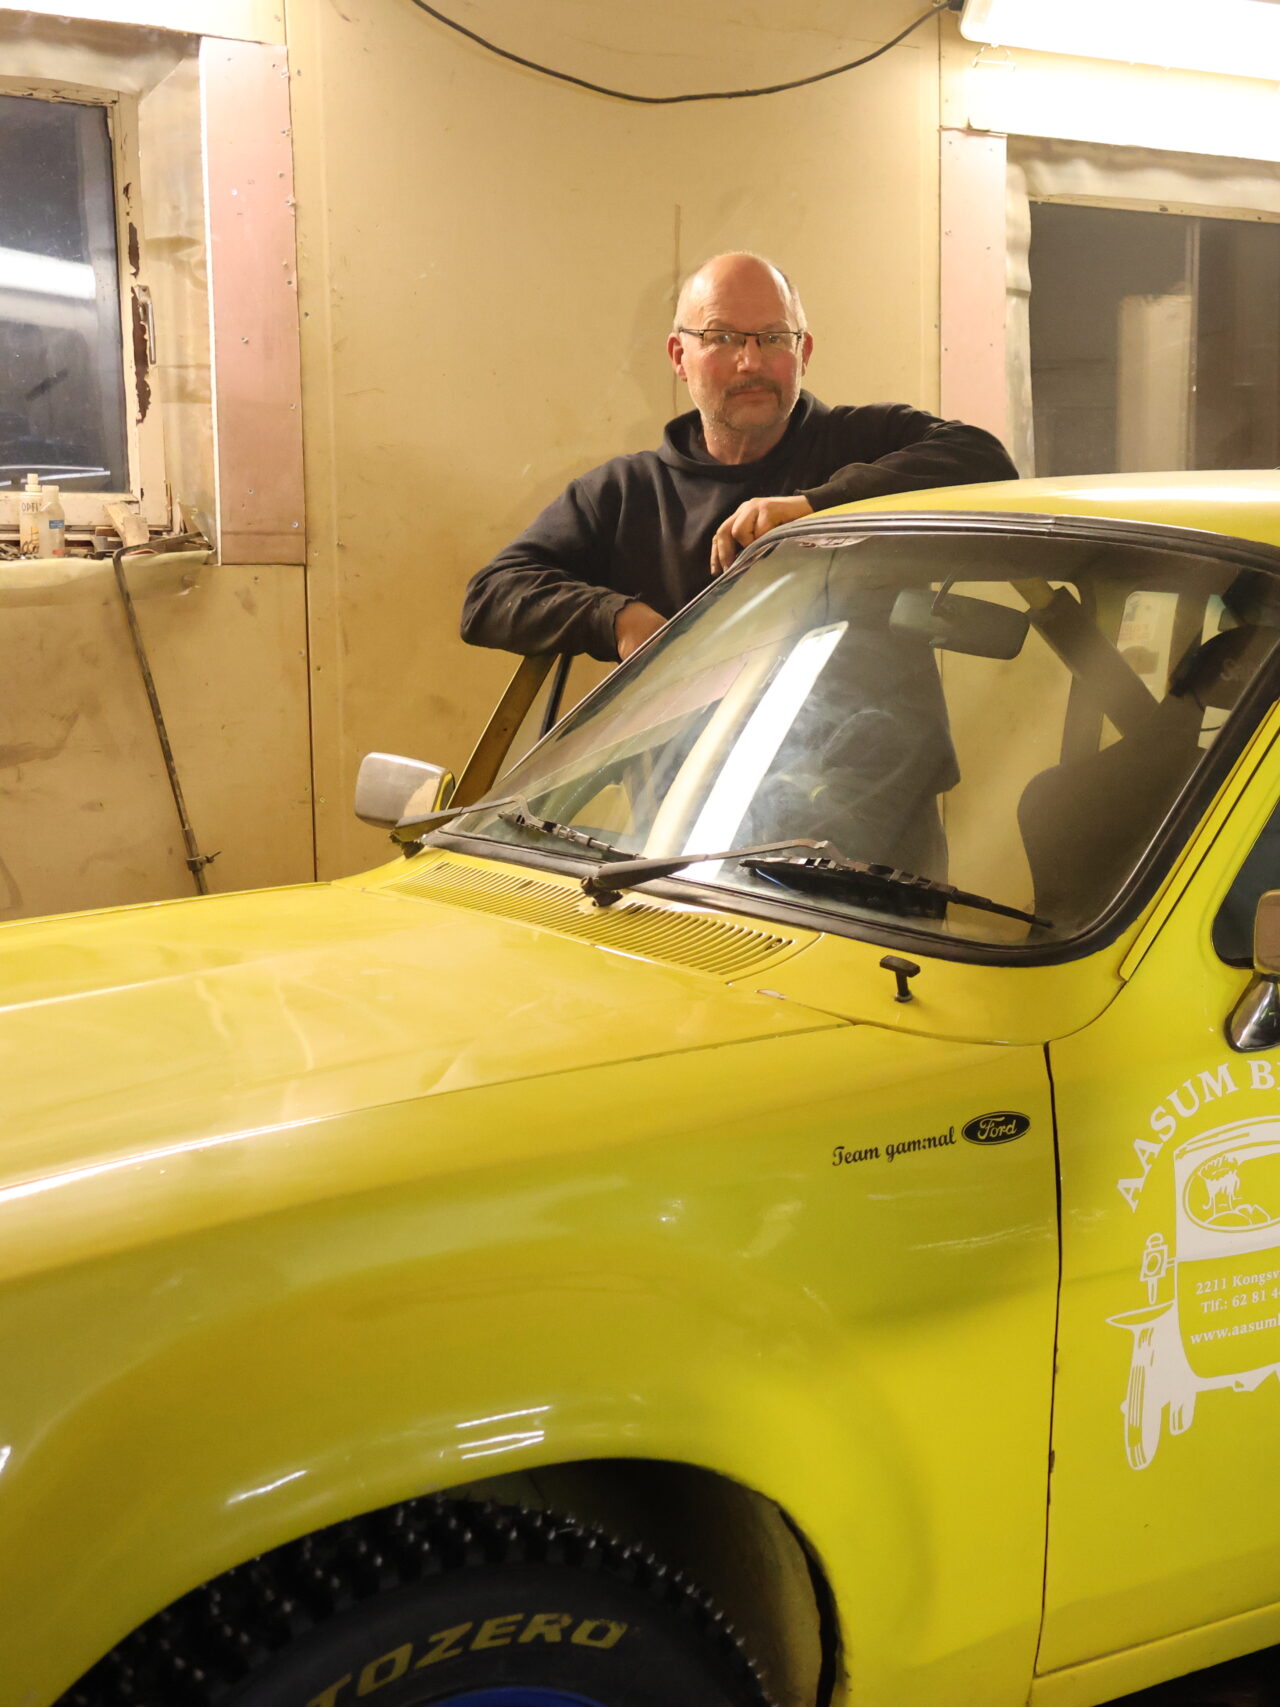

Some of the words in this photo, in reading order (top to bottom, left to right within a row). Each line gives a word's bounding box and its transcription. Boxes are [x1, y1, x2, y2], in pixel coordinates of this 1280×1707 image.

[832, 1146, 881, 1166] Team
[977, 1116, 1018, 1140] Ford
[1116, 1062, 1239, 1213] AASUM
[1196, 1277, 1227, 1295] 2211
[1201, 1298, 1228, 1314] Tlf.:
[1232, 1294, 1247, 1307] 62
[1252, 1290, 1266, 1303] 81
